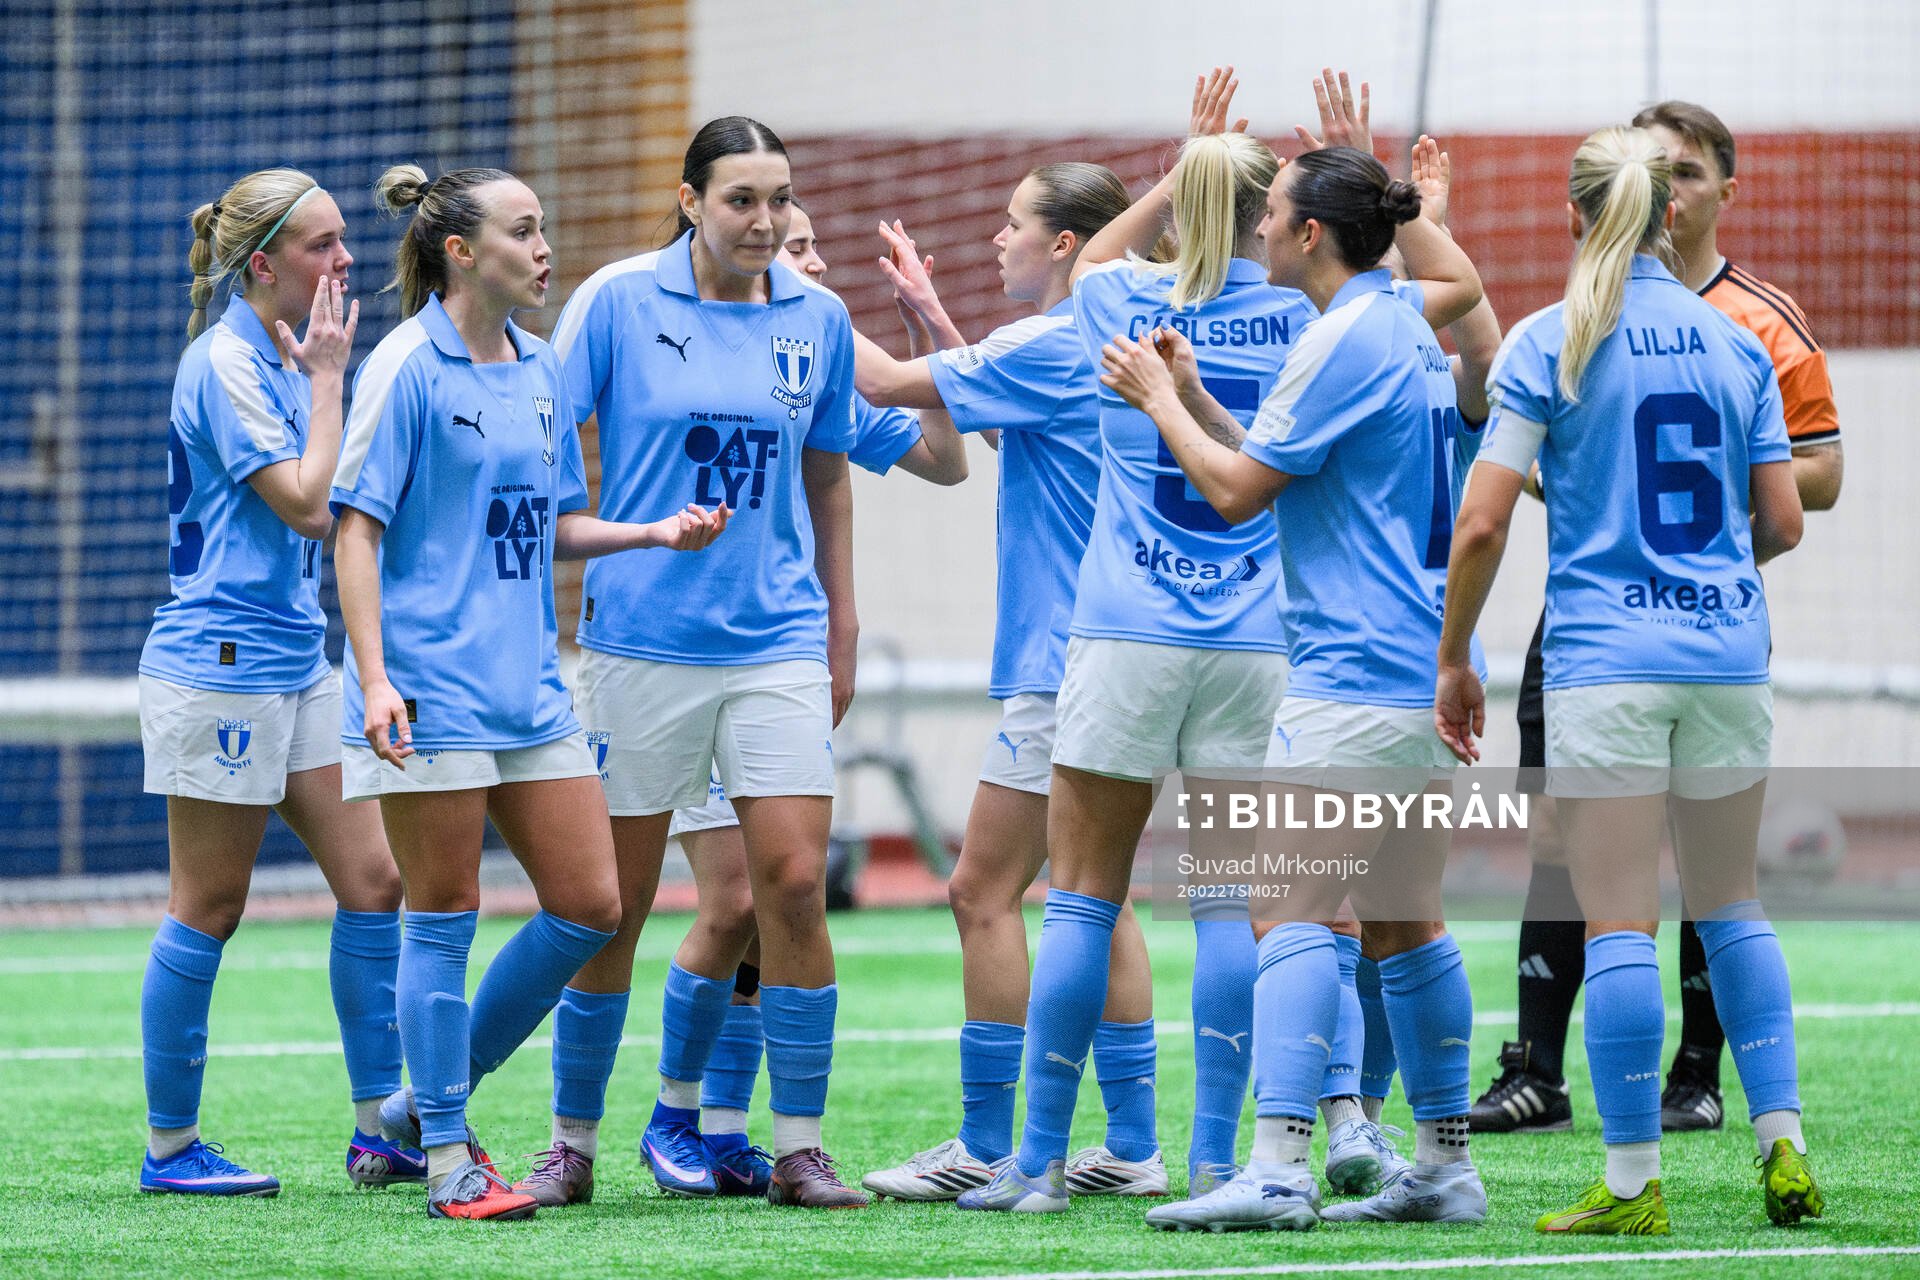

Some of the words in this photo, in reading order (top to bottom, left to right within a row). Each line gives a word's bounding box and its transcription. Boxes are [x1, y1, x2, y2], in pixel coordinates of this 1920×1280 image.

[1626, 327, 1707, 356] LILJA
[689, 411, 710, 422] THE
[711, 413, 755, 424] ORIGINAL
[1634, 392, 1723, 556] 6
[502, 484, 536, 494] ORIGINAL
[1135, 539, 1222, 580] akea
[1174, 582, 1189, 591] OF
[1208, 587, 1240, 597] ELEDA
[1624, 576, 1723, 611] akea
[1740, 1036, 1781, 1052] MFF
